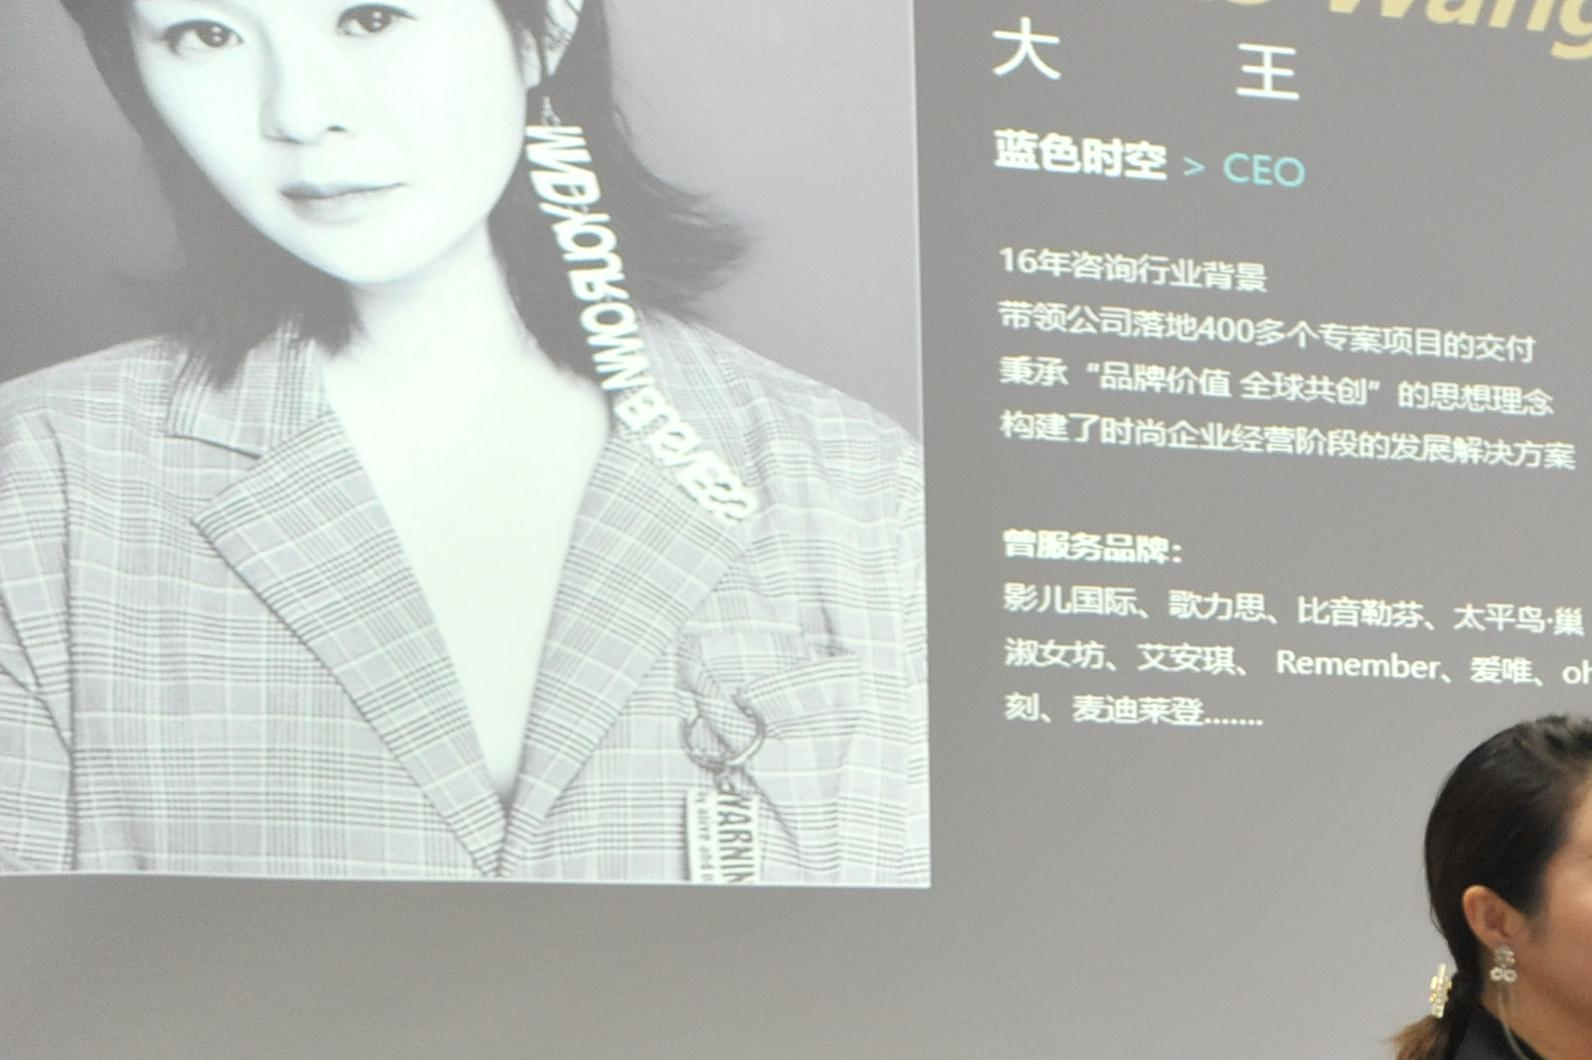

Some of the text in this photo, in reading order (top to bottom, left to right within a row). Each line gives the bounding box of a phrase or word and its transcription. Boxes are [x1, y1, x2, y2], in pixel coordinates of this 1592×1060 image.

[990, 16, 1300, 100] 大 王
[993, 128, 1168, 181] 蓝色时空
[1222, 152, 1306, 187] CEO
[998, 247, 1268, 293] 16年咨询行业背景
[997, 299, 1537, 364] 带领公司落地400多个专案项目的交付
[1000, 410, 1577, 471] 构建了时尚企业经营阶段的发展解决方案
